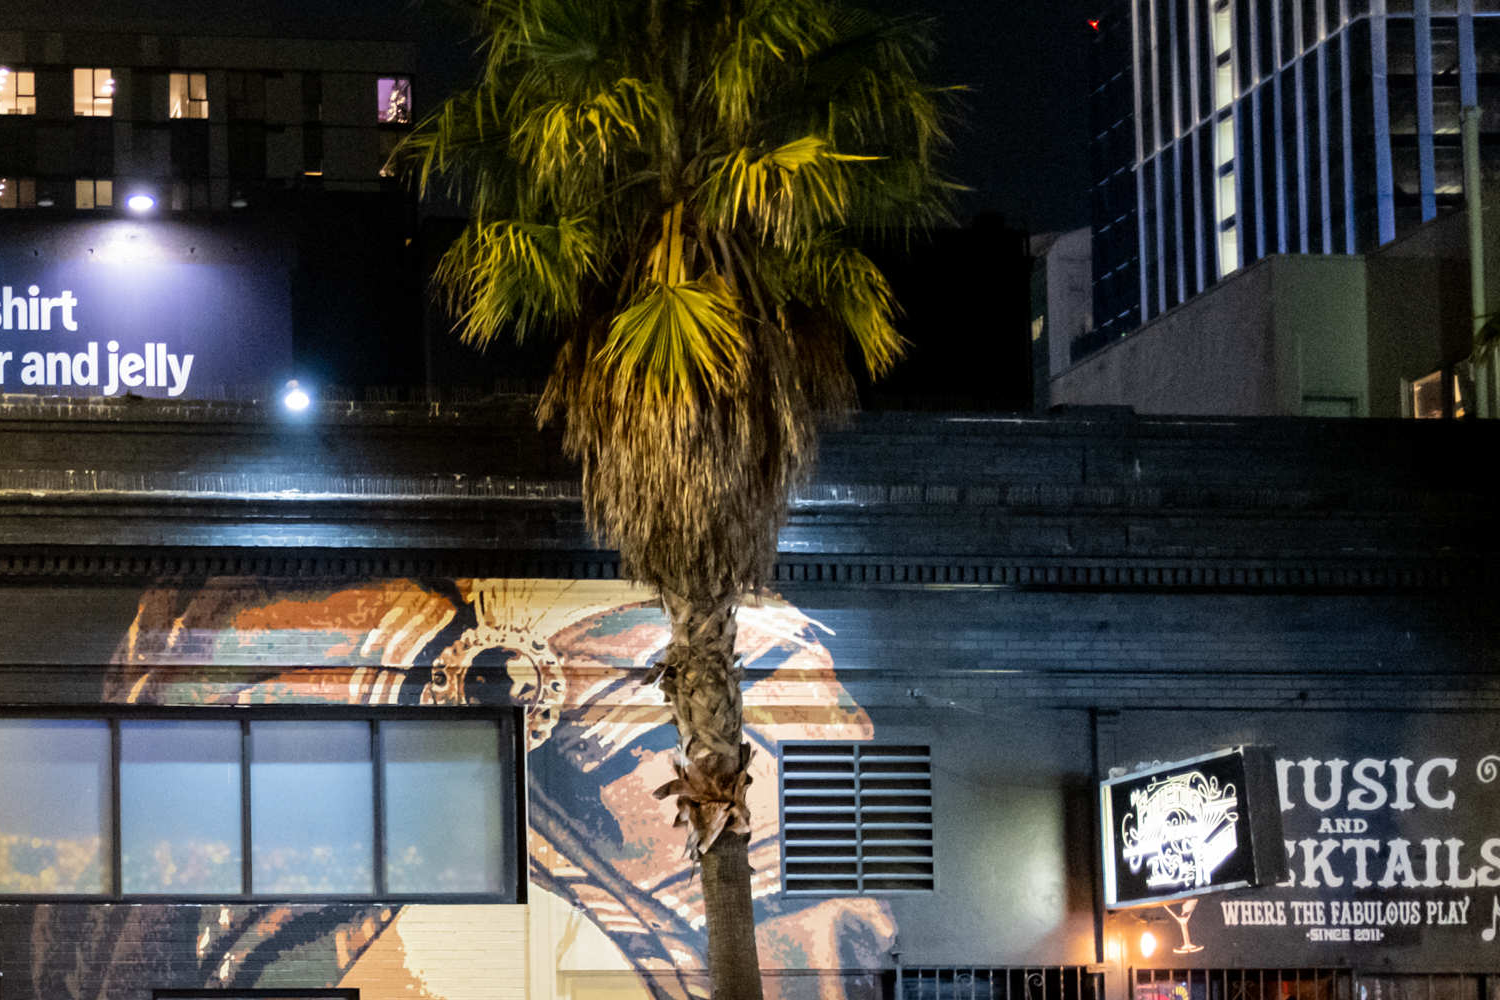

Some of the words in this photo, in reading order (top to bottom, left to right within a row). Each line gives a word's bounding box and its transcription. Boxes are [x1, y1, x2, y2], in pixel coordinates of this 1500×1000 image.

[20, 341, 99, 386] and
[103, 340, 195, 397] jelly
[1317, 818, 1368, 834] AND
[1276, 838, 1500, 888] KTAILS
[1221, 900, 1287, 926] WHERE
[1291, 900, 1326, 926] THE
[1330, 900, 1421, 926] FABULOUS
[1426, 896, 1471, 926] PLAY
[1310, 928, 1351, 942] SINCE
[1353, 928, 1381, 942] 2011
